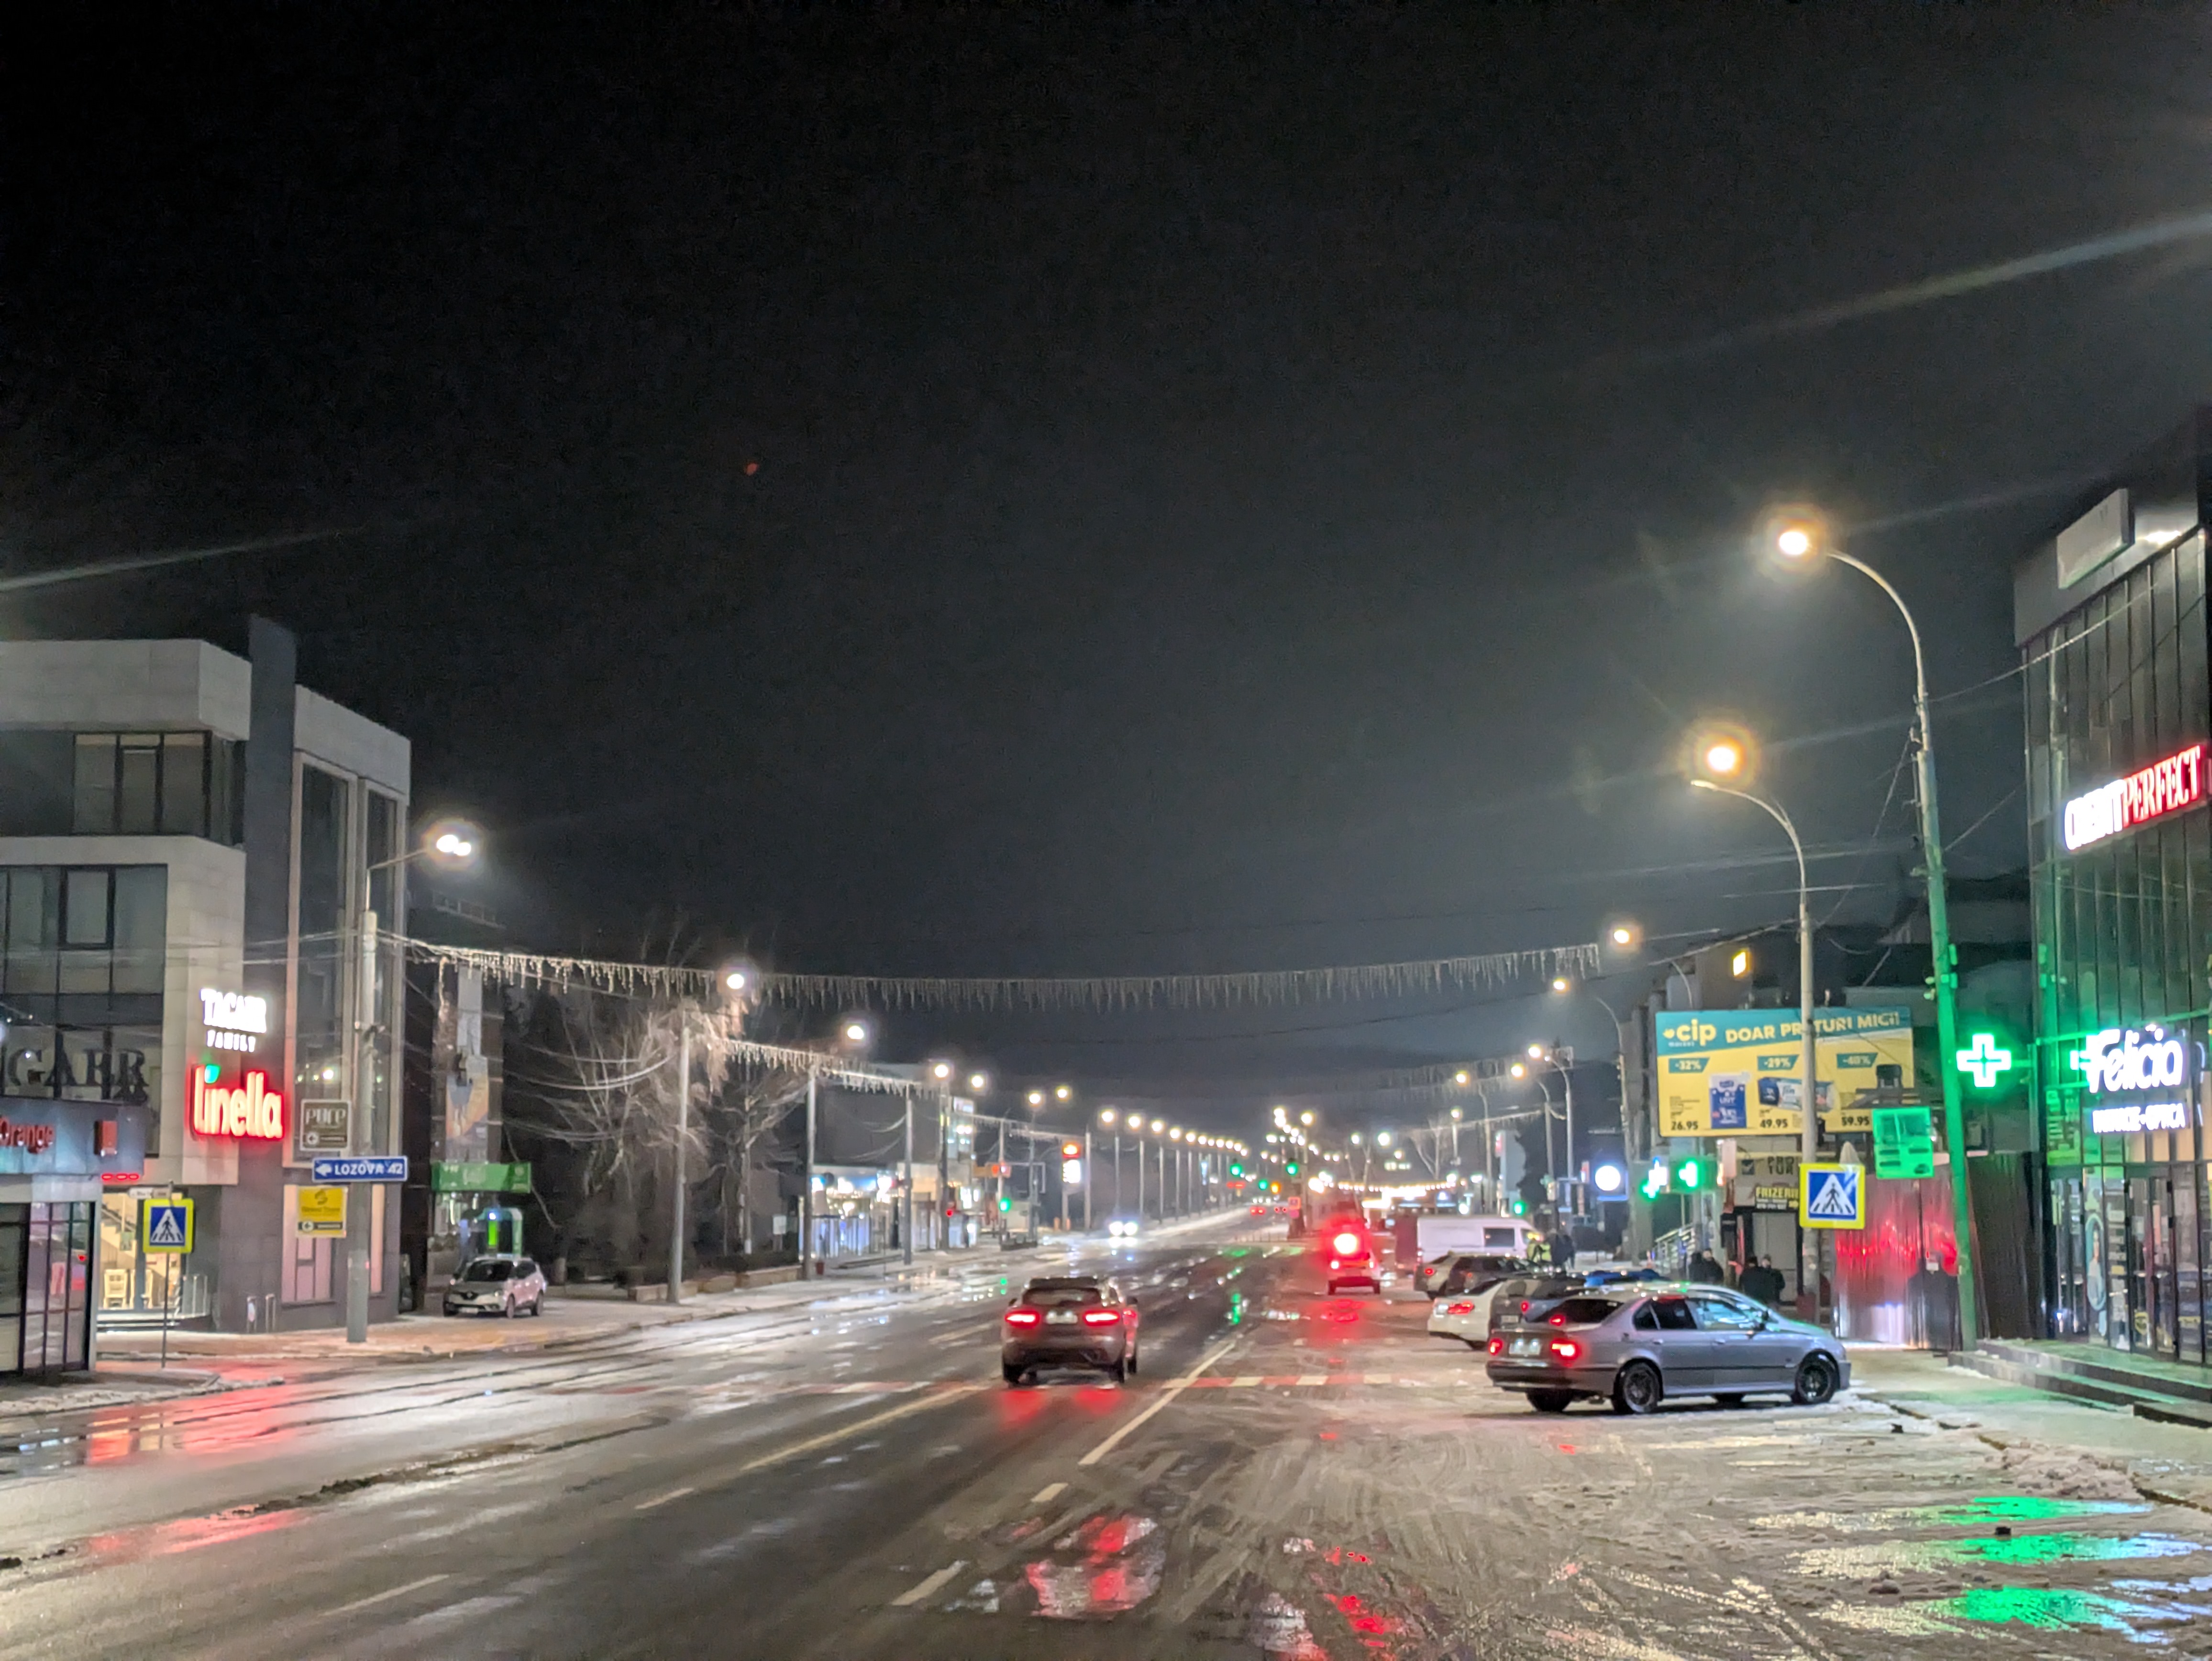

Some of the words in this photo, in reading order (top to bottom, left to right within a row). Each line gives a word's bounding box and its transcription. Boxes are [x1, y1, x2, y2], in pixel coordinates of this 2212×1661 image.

[1677, 1019, 1716, 1046] cip
[1725, 1025, 1775, 1043] DOAR
[1781, 1016, 1852, 1037] PRTURI
[388, 1163, 403, 1174] 42
